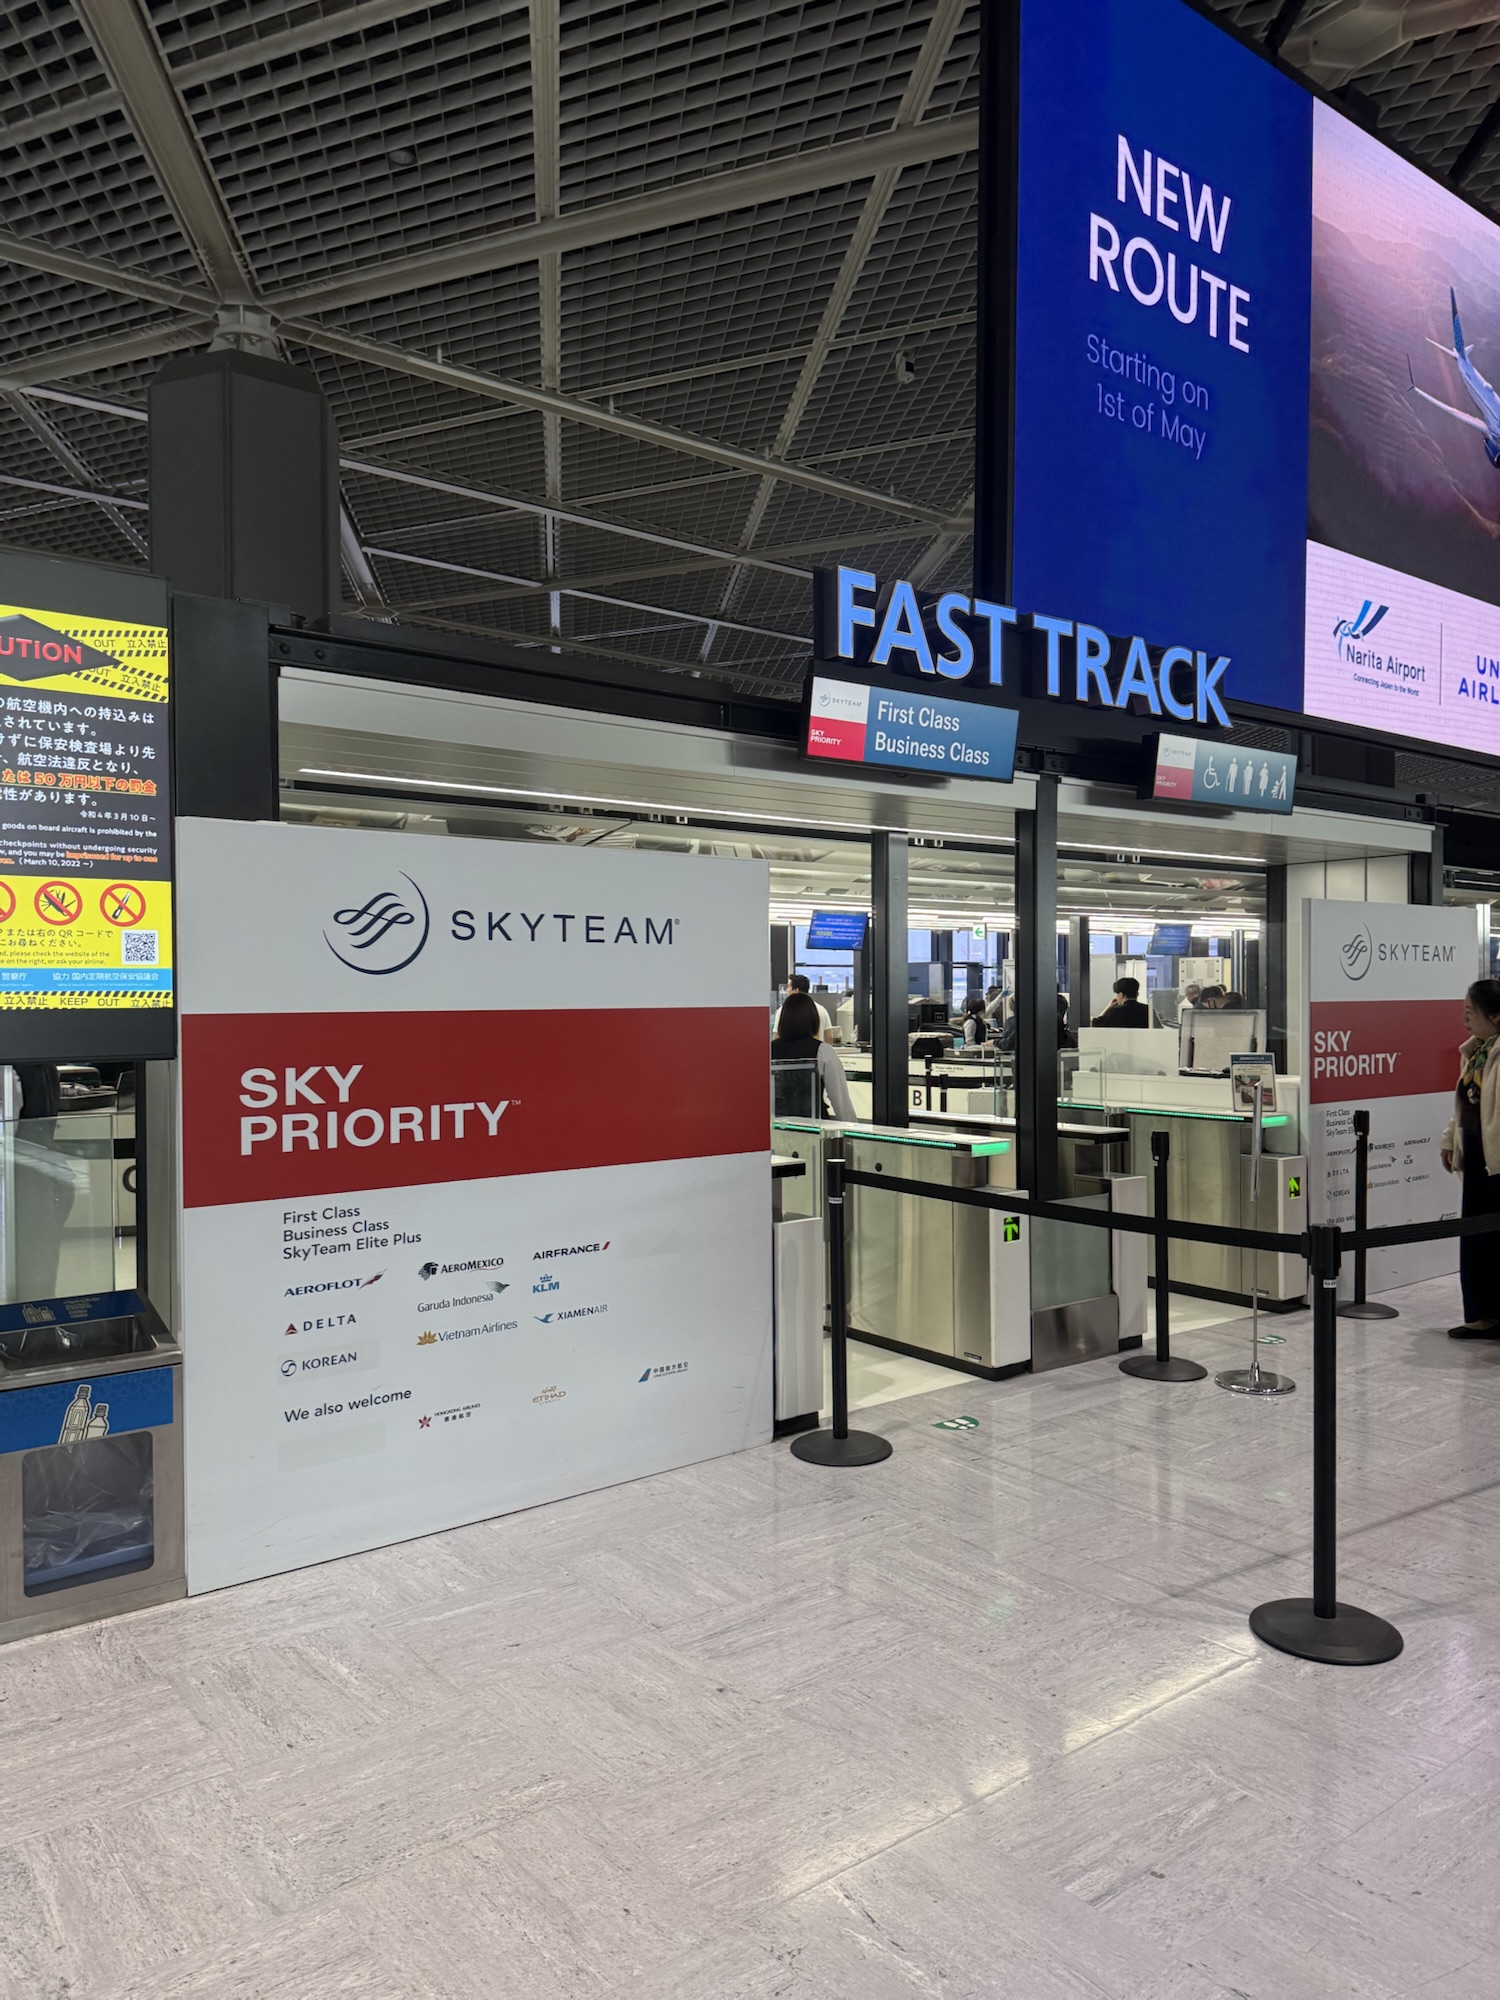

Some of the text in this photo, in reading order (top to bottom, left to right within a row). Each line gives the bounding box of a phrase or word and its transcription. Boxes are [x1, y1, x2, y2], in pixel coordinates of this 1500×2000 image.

[1117, 134, 1231, 254] NEW
[1089, 212, 1250, 353] ROUTE
[1087, 334, 1209, 411] Starting on
[1098, 383, 1206, 460] 1st of May
[93, 639, 116, 648] OUT
[126, 639, 167, 649] 立入禁止
[836, 565, 1232, 728] FAST TRACK
[1346, 643, 1426, 682] Narita Airport
[120, 674, 162, 693] 立入禁止
[1353, 672, 1380, 688] Connecting
[1380, 680, 1394, 690] Japan
[1399, 685, 1407, 693] the
[1407, 686, 1420, 697] World
[877, 700, 960, 732] First Class
[0, 715, 97, 737] されています。
[810, 735, 841, 745] PRIORITY
[874, 731, 990, 765] Business Class
[0, 752, 139, 775] 、航空法違反となり、
[0, 786, 97, 812] 性があります。
[2, 823, 25, 831] goods
[38, 824, 60, 832] board
[62, 826, 88, 834] aircraft
[97, 828, 133, 837] prohibited
[135, 830, 144, 838] by
[39, 851, 55, 859] may
[83, 844, 126, 854] undergoing
[127, 847, 158, 855] security
[29, 958, 47, 966] right,
[4, 996, 48, 1006] 立入禁止
[60, 998, 120, 1006] KEEP OUT
[130, 999, 171, 1008] 立入禁止
[1314, 1031, 1351, 1053] SKY
[1314, 1052, 1397, 1079] PRIORITY
[239, 1064, 363, 1109] SKY
[913, 1091, 922, 1106] B
[1326, 1119, 1346, 1127] Business
[1326, 1128, 1347, 1138] SkyTeam
[1332, 1168, 1349, 1176] DELTA
[283, 1206, 361, 1225] First Class
[284, 1219, 389, 1242] Business Class
[283, 1232, 422, 1262] SkyTeam Elite Plus
[284, 1278, 363, 1297] AEROFLOT
[532, 1281, 560, 1293] KLM
[417, 1293, 494, 1312] Garuda Indonesia
[557, 1304, 608, 1321] XIAMENAIR
[303, 1314, 357, 1332] DELTA
[438, 1320, 518, 1342] Vietnam Airlines
[302, 1352, 357, 1371] KOREAN
[284, 1390, 412, 1423] We also welcome
